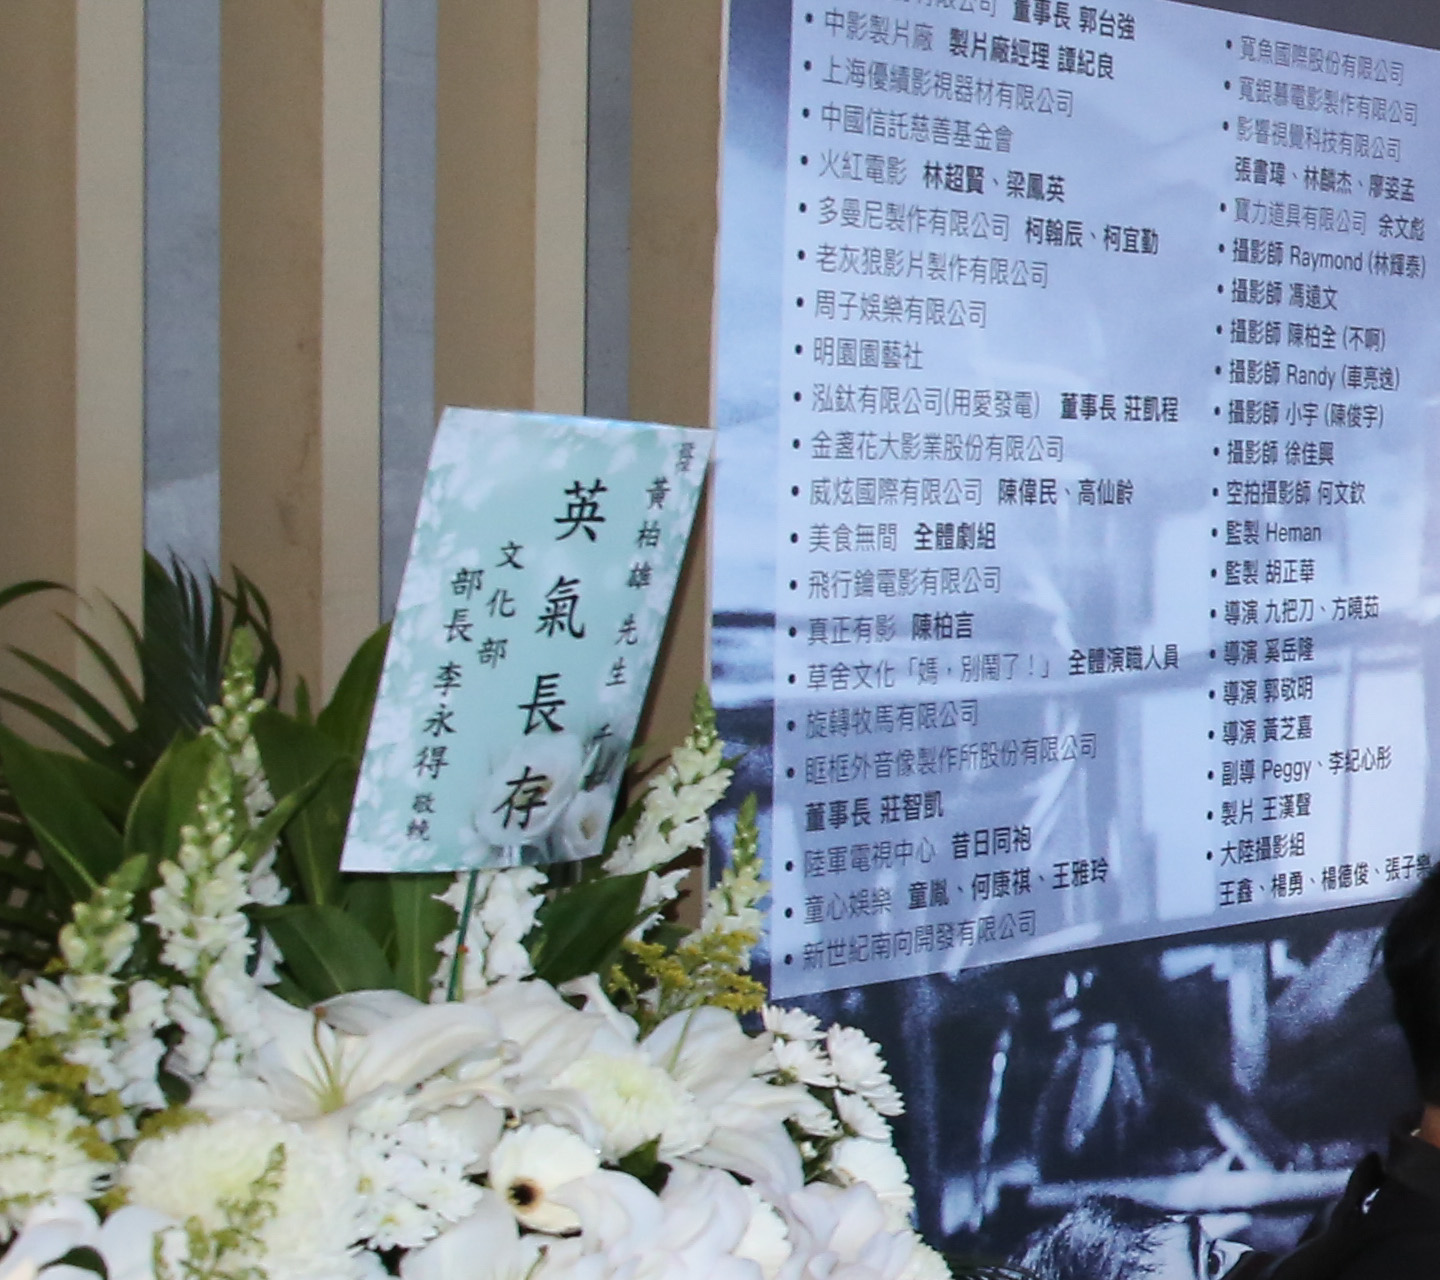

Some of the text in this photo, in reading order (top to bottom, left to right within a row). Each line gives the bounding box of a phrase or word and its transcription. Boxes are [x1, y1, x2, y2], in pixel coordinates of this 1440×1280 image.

[1079, 6, 1135, 41] 郭台強
[824, 8, 1115, 80] 中影製片廠 製片廠經理 譚紀良
[1239, 35, 1404, 87] 寬魚國際股份有限公司
[821, 102, 1013, 154] 中國信託慈善基金會
[1237, 115, 1401, 162] 影響視覺科技有限公司
[820, 148, 1065, 204] 火紅電影 林超賢、梁鳳英
[818, 195, 1158, 256] 多曼尼製作有限公司 柯翰辰、柯宜勤
[816, 243, 1048, 289] 老灰狼影片製作有限公司
[1232, 237, 1284, 267] 攝影師
[1290, 245, 1363, 271] Raymond
[1231, 277, 1282, 306] 攝影師
[814, 289, 987, 329] 周子娛樂有限公司
[1230, 318, 1281, 346] 攝影師
[813, 336, 923, 370] 明園園藝社
[1229, 359, 1281, 385] 攝影師
[1287, 363, 1336, 390] Randy
[811, 383, 1179, 422] 泓鈦有限公司(用愛發電) 董事長 莊凱程
[1228, 399, 1280, 426] 攝影師
[1285, 402, 1318, 427] 小宇
[811, 430, 1064, 463] 金盞花大影業股份有限公司
[1227, 439, 1279, 466] 攝影師
[998, 478, 1134, 506] 陳偉民、高仙齡
[1226, 480, 1366, 506] 空拍攝影師 何文欽
[626, 477, 672, 590] 黃柏雄
[809, 522, 997, 553] 美食無間 全體劇組
[1225, 520, 1322, 546] 監製 Heman
[1224, 558, 1315, 586] 監製 胡正華
[477, 541, 525, 669] 文化部
[1224, 599, 1259, 626] 導演
[807, 612, 975, 645] 真正有影 陳柏言
[493, 479, 608, 830] 英氣長存
[1068, 644, 1179, 677] 全體演職人員
[1224, 637, 1315, 667] 導演 奚岳隆
[1223, 675, 1314, 707] 導演 郭敬明
[805, 699, 978, 740] 旋轉牧馬有限公司
[1222, 714, 1313, 746] 導演 黃芝嘉
[1221, 759, 1255, 788] 副導
[805, 790, 944, 832] 董事長 莊智凱
[1221, 799, 1254, 827] 製片
[803, 825, 1032, 879] 陸軍電視中心 昔日同袍
[1220, 832, 1306, 867] 大陸攝影組
[804, 885, 892, 925] 童心娛樂
[802, 910, 1036, 972] 新世紀南向開發有限公司
